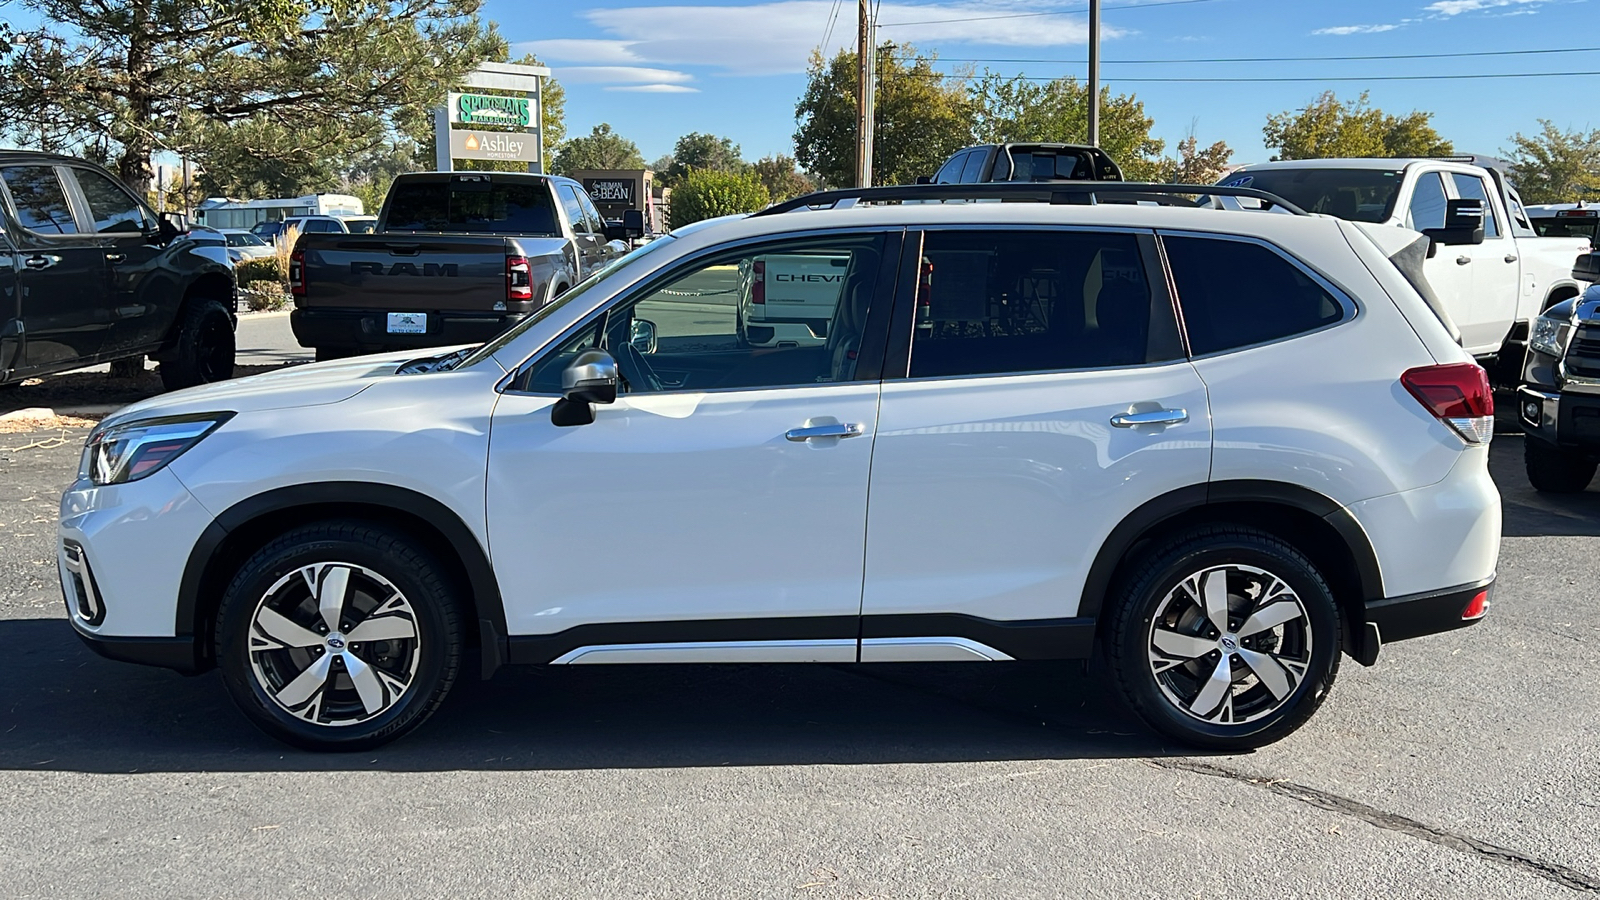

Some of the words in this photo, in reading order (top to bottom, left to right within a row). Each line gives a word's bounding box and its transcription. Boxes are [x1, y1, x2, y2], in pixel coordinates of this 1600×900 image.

[472, 115, 521, 124] WAREHOUSE
[480, 135, 524, 157] Ashley
[600, 181, 623, 189] HUMAN
[600, 188, 629, 200] BEAN
[350, 261, 458, 277] RAM
